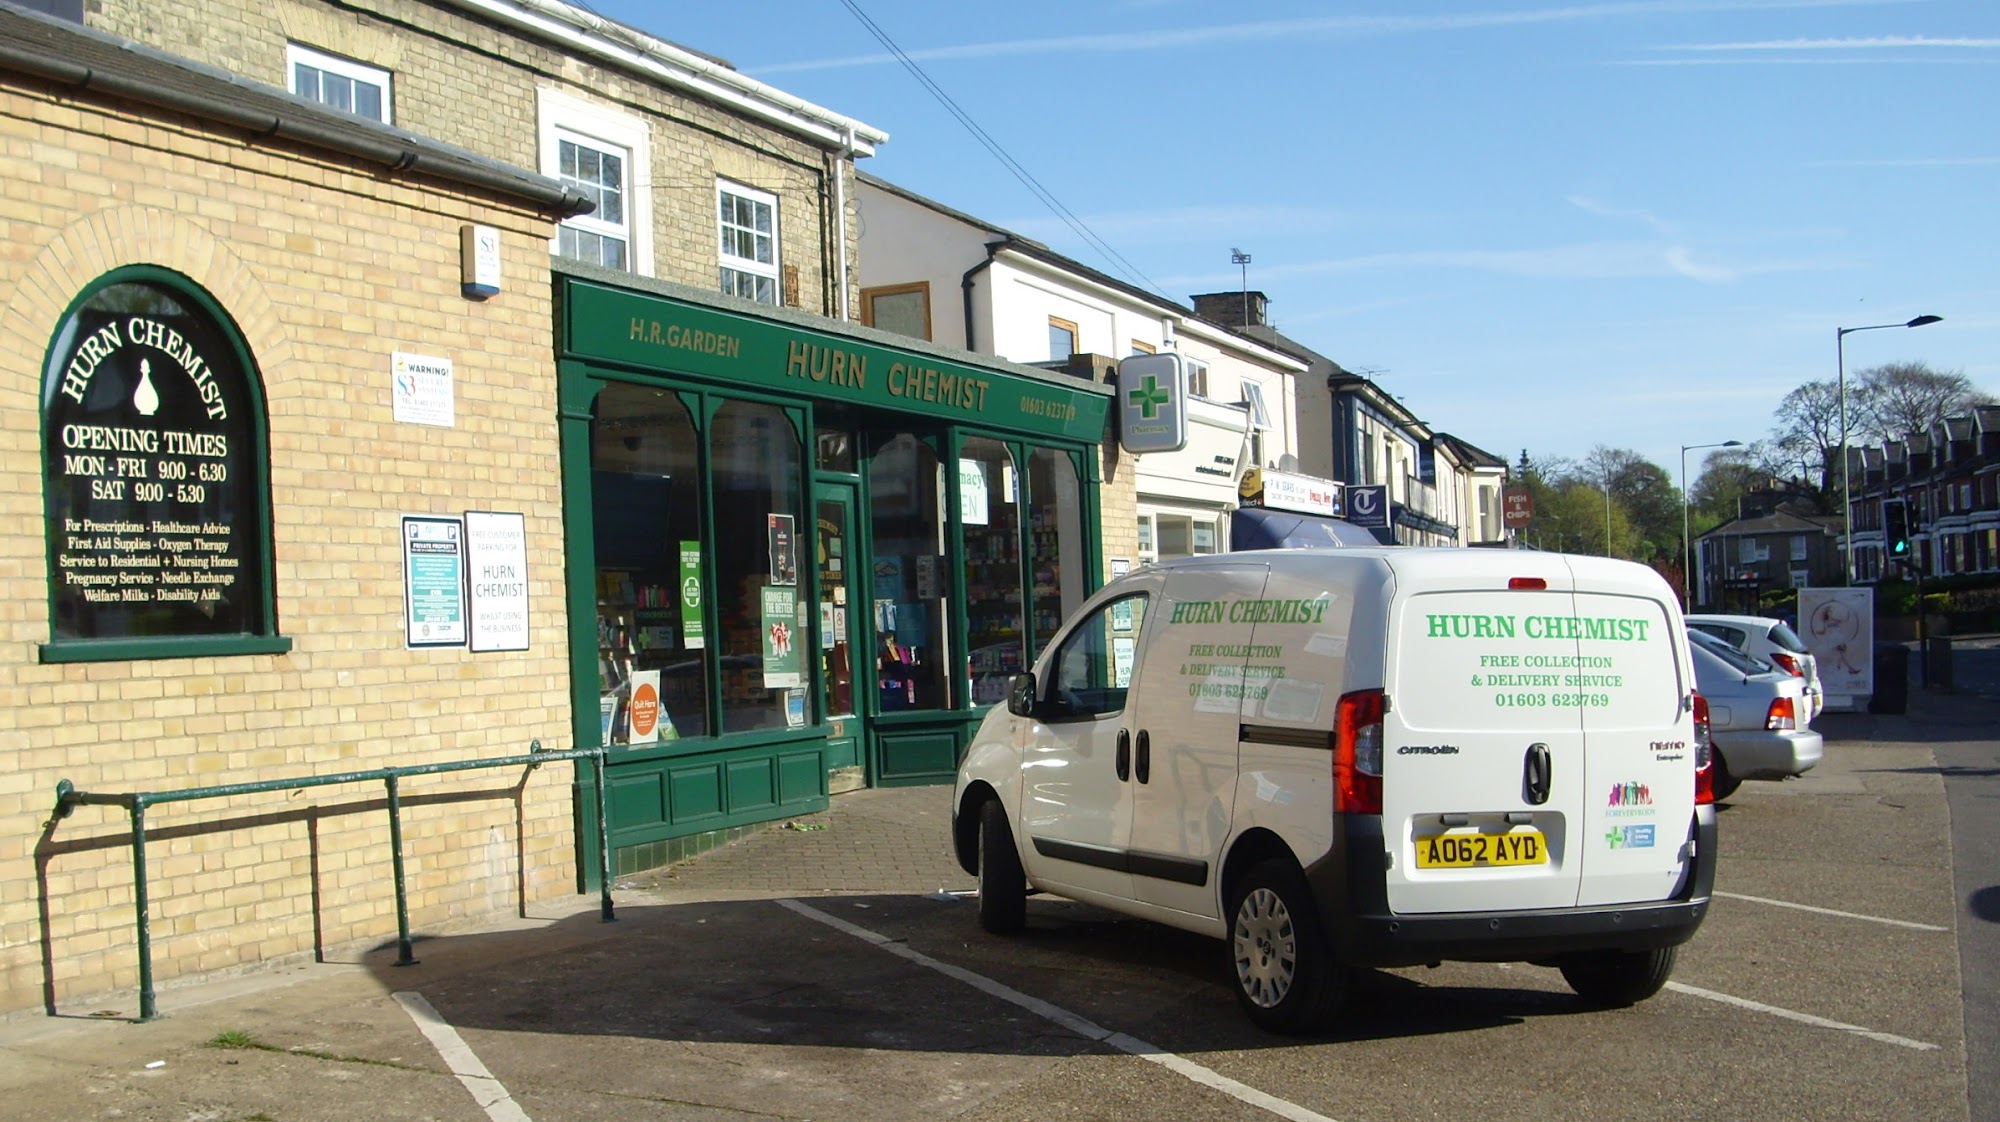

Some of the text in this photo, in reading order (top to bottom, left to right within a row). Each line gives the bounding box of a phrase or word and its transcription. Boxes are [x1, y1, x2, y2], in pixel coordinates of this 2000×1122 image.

[61, 317, 227, 421] HURN CHEMIST
[408, 363, 449, 377] WARNING!
[787, 341, 989, 412] HURN CHEMIST
[1021, 396, 1044, 416] 01603
[1130, 425, 1169, 435] Pharmacy
[63, 424, 227, 457] OPENING TIMES
[64, 455, 105, 476] MON
[117, 457, 147, 478] FRI
[158, 461, 186, 480] 9.00
[199, 464, 227, 482] 6.30
[92, 480, 125, 500] SAT
[135, 483, 163, 502] 9.00
[177, 484, 205, 503] 5.30
[1508, 495, 1527, 503] FISH
[1506, 511, 1530, 520] CHIPS
[65, 519, 81, 532] For
[83, 519, 144, 535] Prescriptions
[152, 521, 200, 534] Healthcare
[202, 522, 231, 535] Advice
[67, 536, 92, 550] First
[95, 537, 111, 550] Aid
[113, 537, 151, 552] Supplies
[159, 538, 192, 553] Oxygen
[194, 538, 229, 553] Therapy
[60, 554, 96, 567] Service
[98, 556, 108, 567] to
[110, 554, 161, 567] Residential
[173, 555, 209, 569] Nursing
[211, 555, 239, 567] Homes
[66, 571, 118, 586] Pregnancy
[119, 572, 154, 584] Service
[161, 571, 192, 584] Needle
[193, 571, 235, 585] Exchange
[483, 565, 515, 579] HURN
[84, 589, 120, 602] Welfare
[122, 589, 149, 602] Milks
[157, 588, 199, 603] Disability
[201, 588, 221, 601] Aids
[476, 583, 524, 598] CHEMIST
[766, 602, 794, 614] THE BETTER
[1170, 599, 1329, 624] HURN CHEMIST
[503, 612, 522, 620] USING
[480, 625, 491, 633] THE
[1426, 614, 1649, 641] HURN CHEMIST
[1189, 644, 1282, 658] FREE COLLECTION
[1480, 655, 1612, 668] FREE COLLECTION
[1189, 664, 1238, 678] DELIVERY
[1240, 665, 1286, 679] SERVICE
[1471, 674, 1622, 687] & DELIVERY SERVICE
[1189, 683, 1268, 700] 01603 623769
[1496, 693, 1609, 707] 01603 623769
[1428, 836, 1537, 863] AO62 AYD
